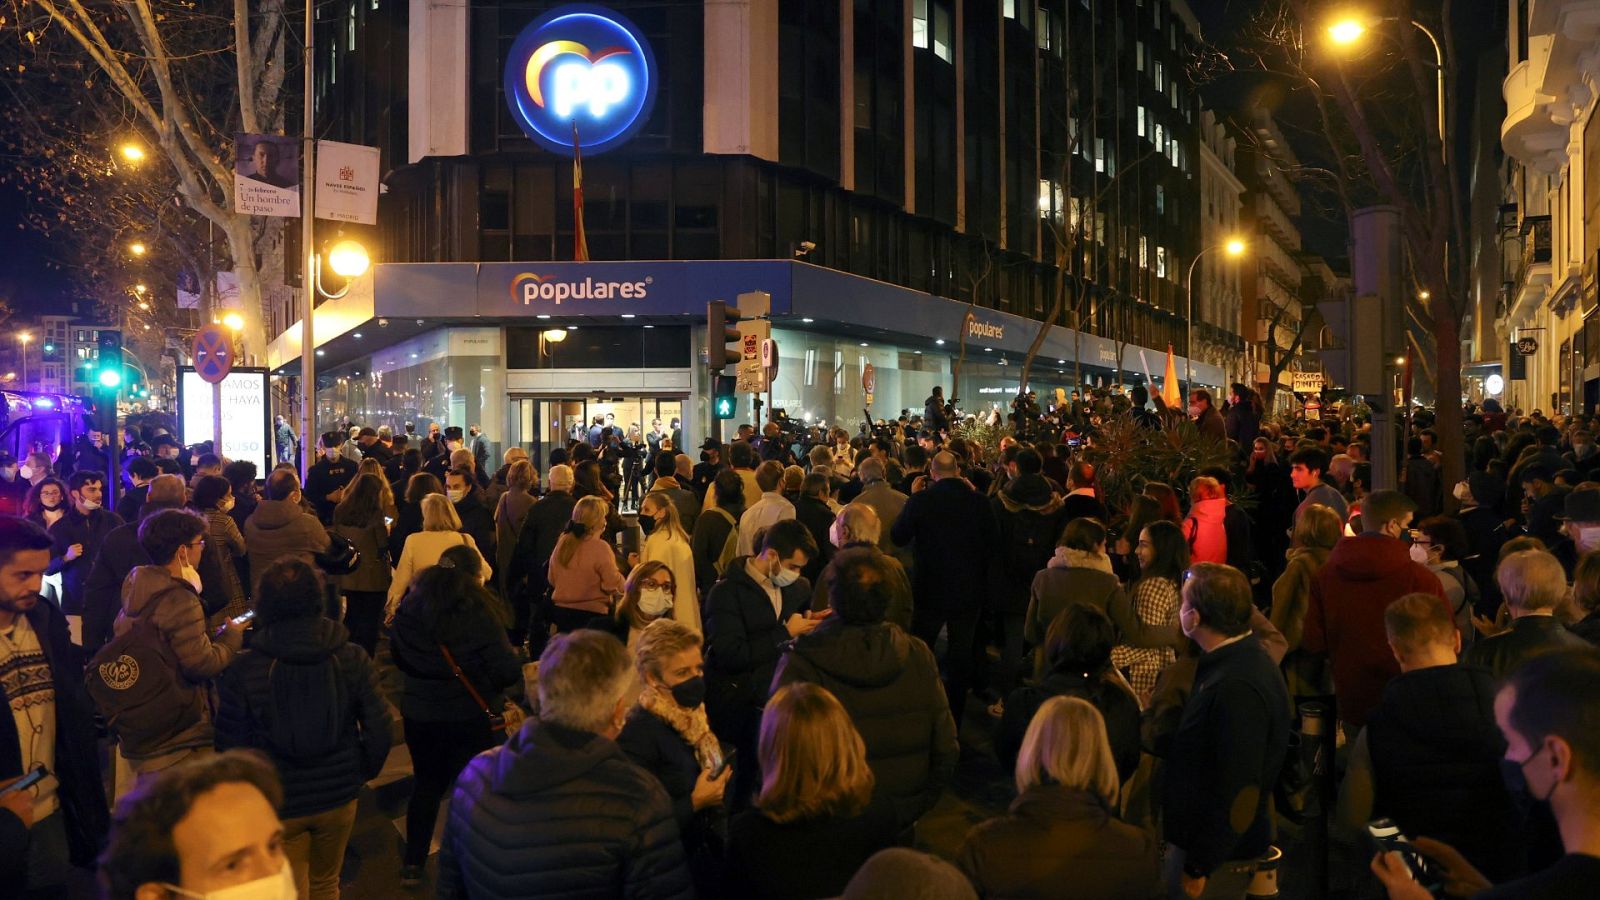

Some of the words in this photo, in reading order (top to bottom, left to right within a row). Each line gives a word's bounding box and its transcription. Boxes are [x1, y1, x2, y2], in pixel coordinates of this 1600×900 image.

[240, 193, 254, 202] Un
[257, 194, 291, 205] hombre
[240, 202, 251, 211] de
[253, 205, 274, 214] paso
[524, 276, 647, 305] populares
[969, 321, 1003, 339] populares
[229, 394, 261, 405] HAYA
